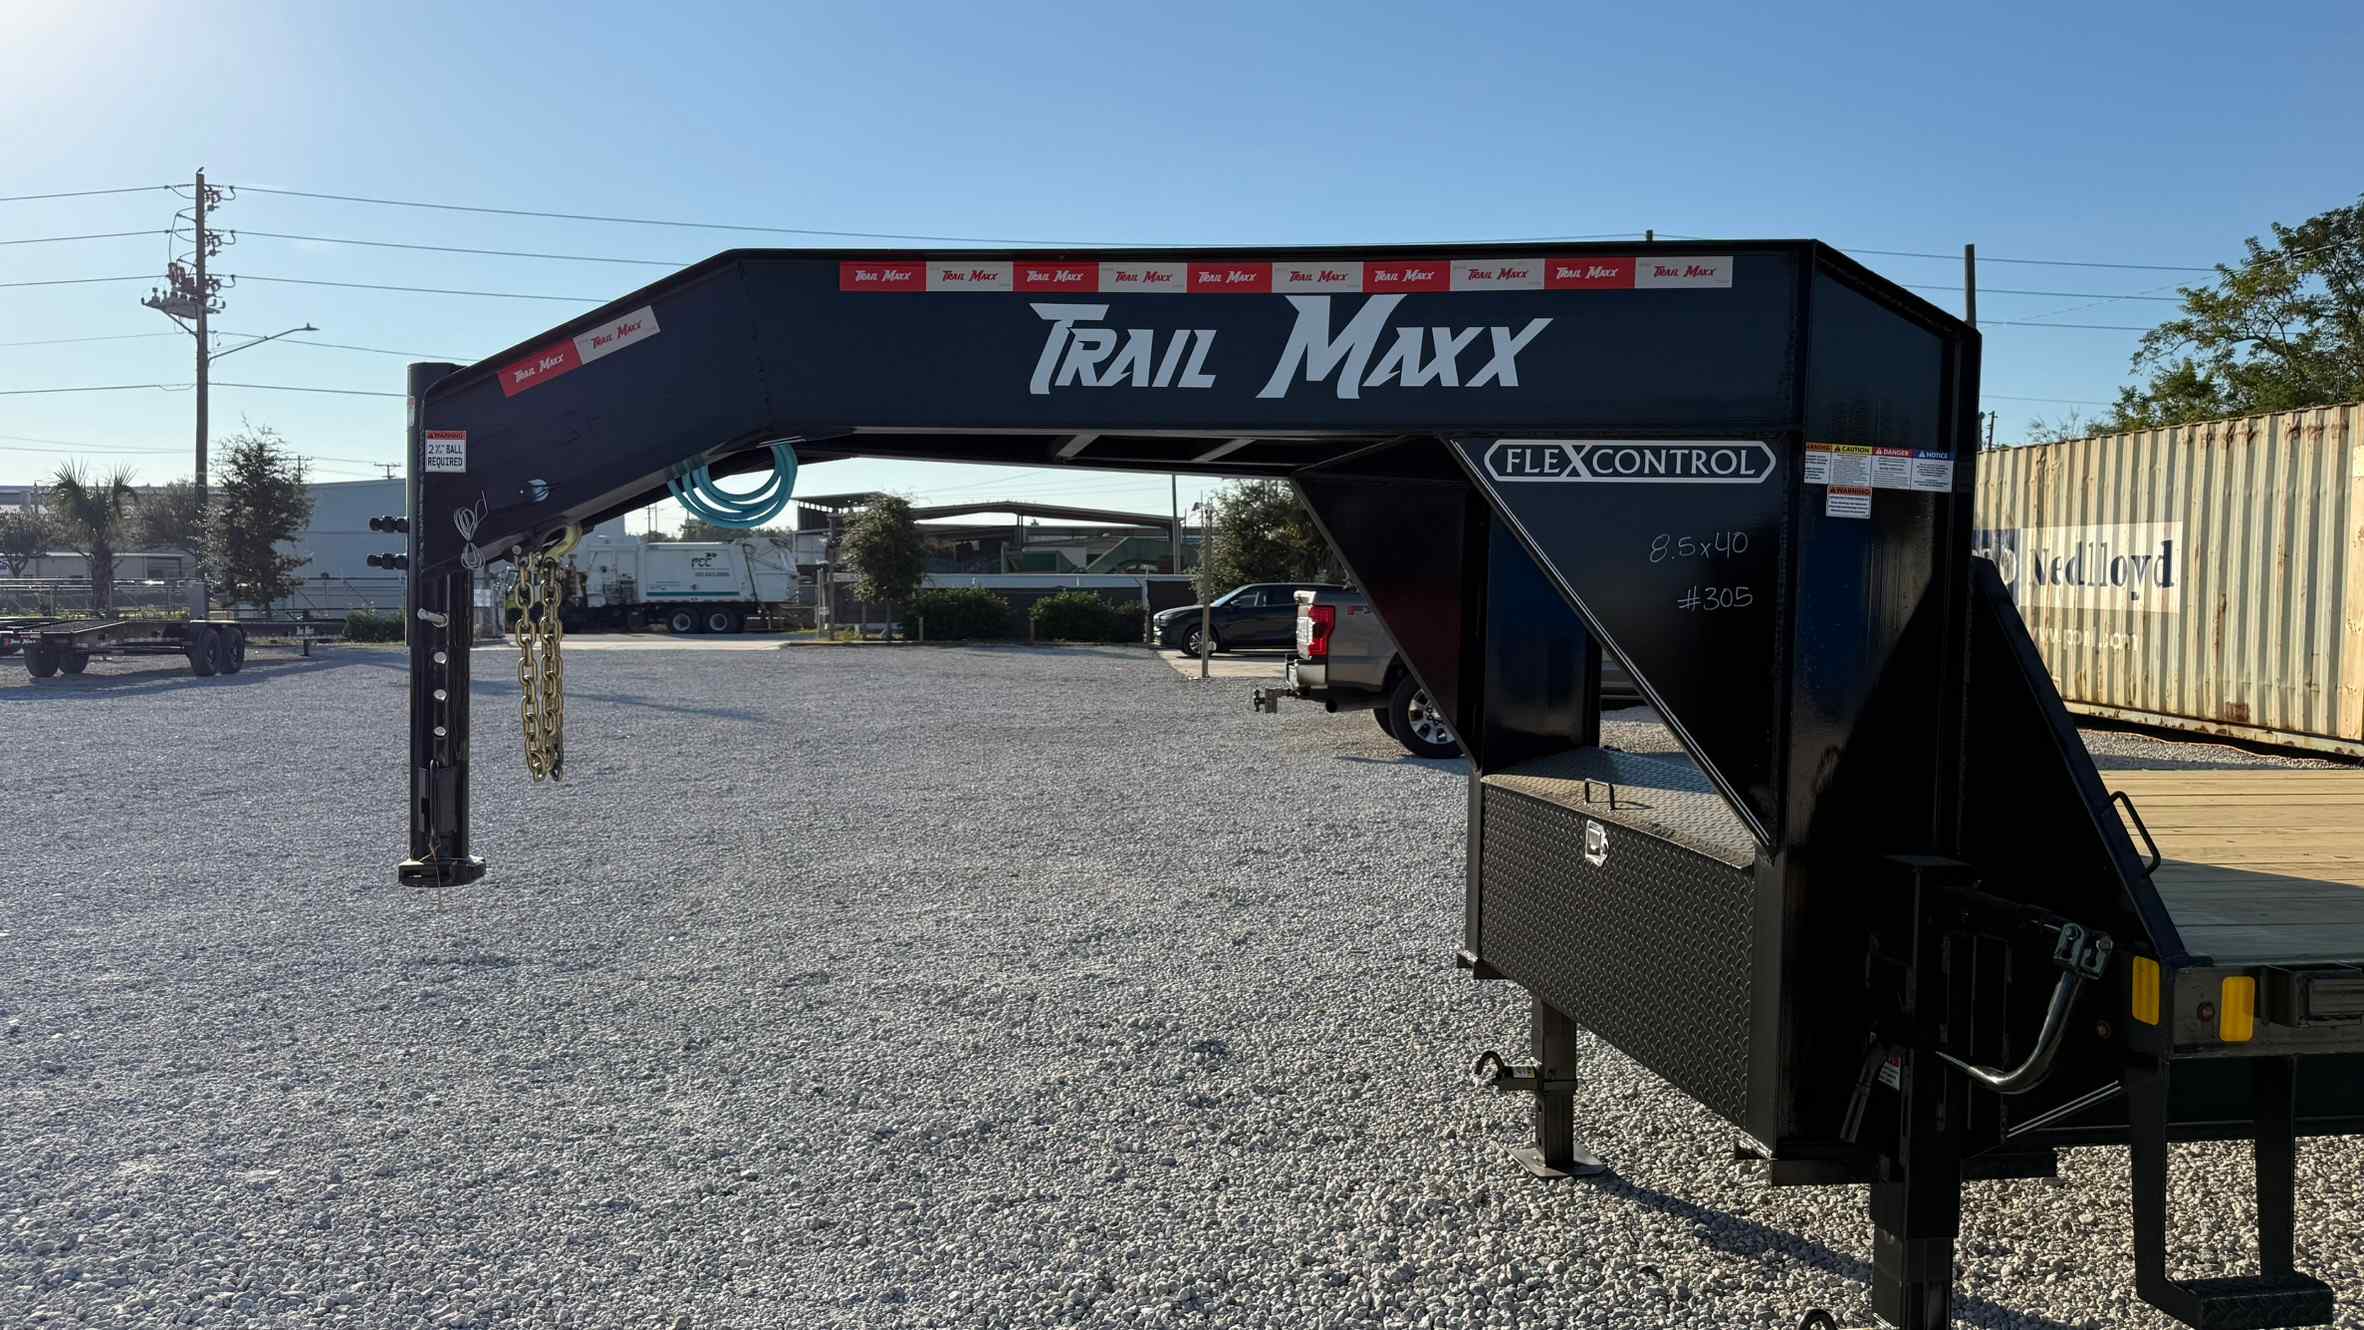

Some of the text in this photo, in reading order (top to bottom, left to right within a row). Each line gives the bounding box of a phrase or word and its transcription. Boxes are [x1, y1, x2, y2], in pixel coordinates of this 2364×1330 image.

[446, 444, 463, 454] BALL
[1841, 446, 1870, 454] CAUTION
[1883, 448, 1909, 456] DANGER
[1926, 451, 1948, 459] NOTICE
[428, 457, 463, 468] REQUIRED
[2030, 539, 2175, 588] Nedlloyd
[1677, 585, 1753, 612] #305
